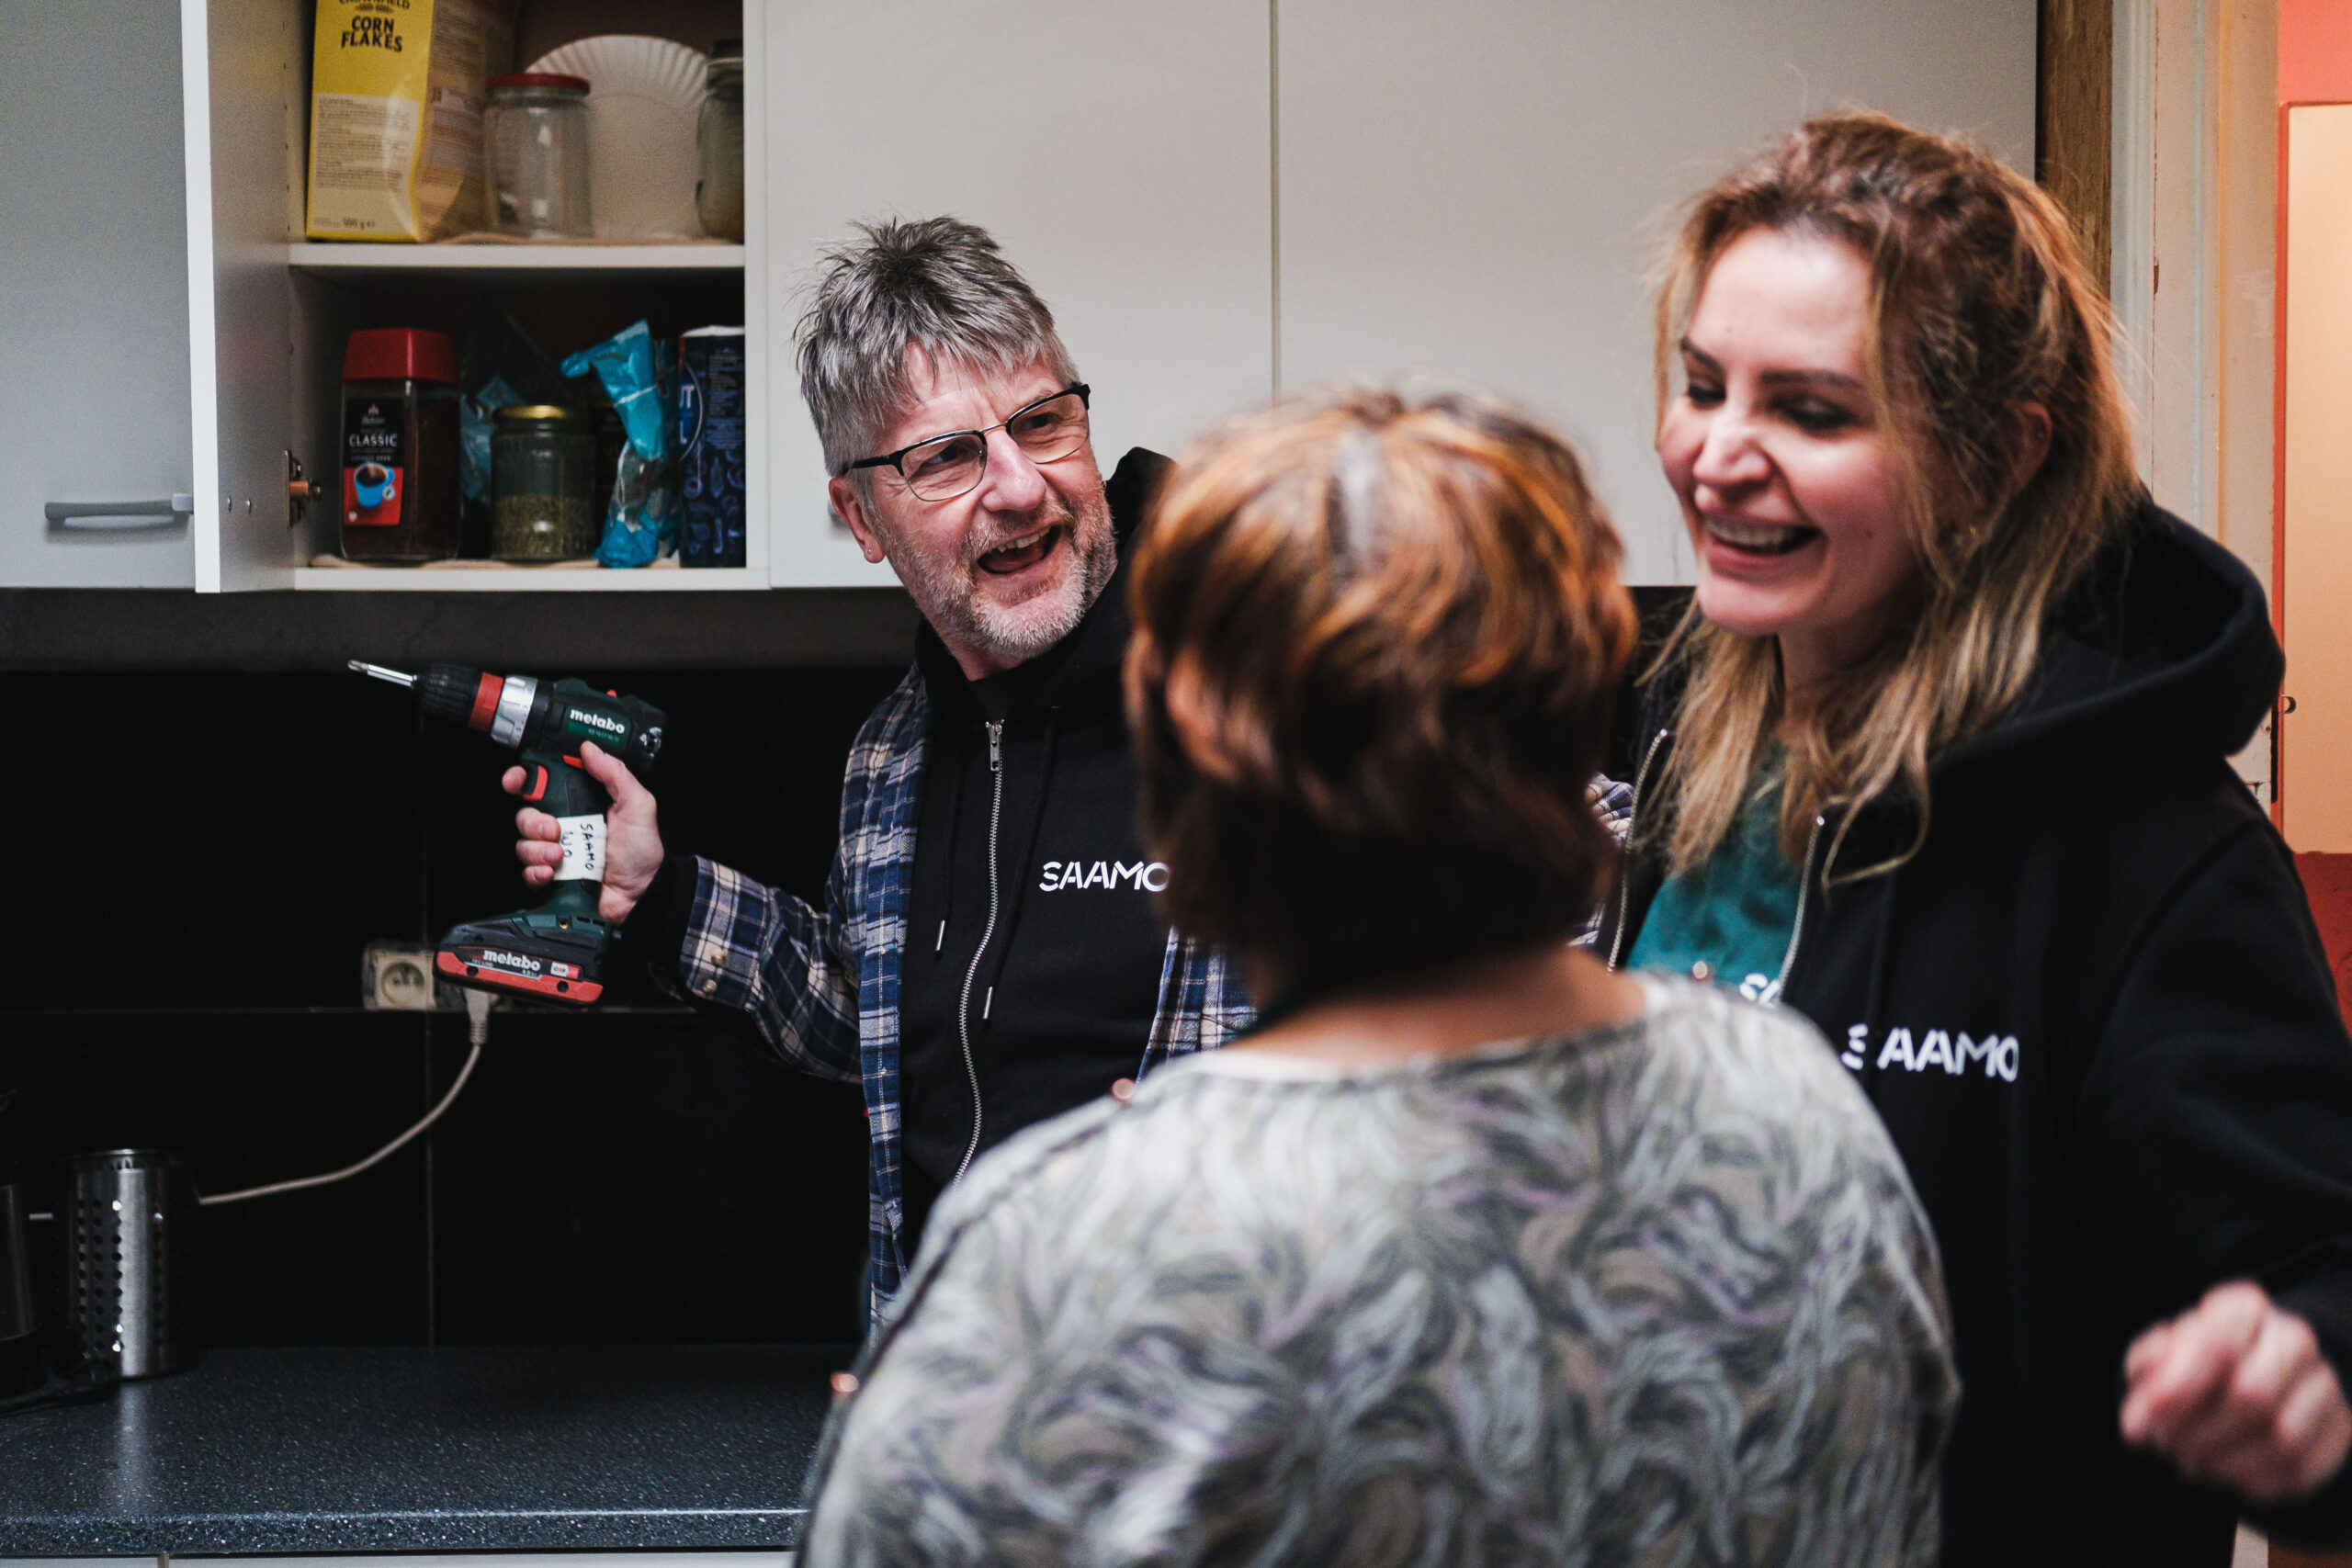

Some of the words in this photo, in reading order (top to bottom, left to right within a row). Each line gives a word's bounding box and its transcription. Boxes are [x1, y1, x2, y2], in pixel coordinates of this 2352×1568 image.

[351, 16, 394, 32] CORN
[341, 31, 402, 53] FLAKES
[349, 433, 398, 447] CLASSIC
[570, 708, 625, 734] metabo
[1038, 860, 1170, 892] SAAMO
[483, 950, 540, 971] metabo
